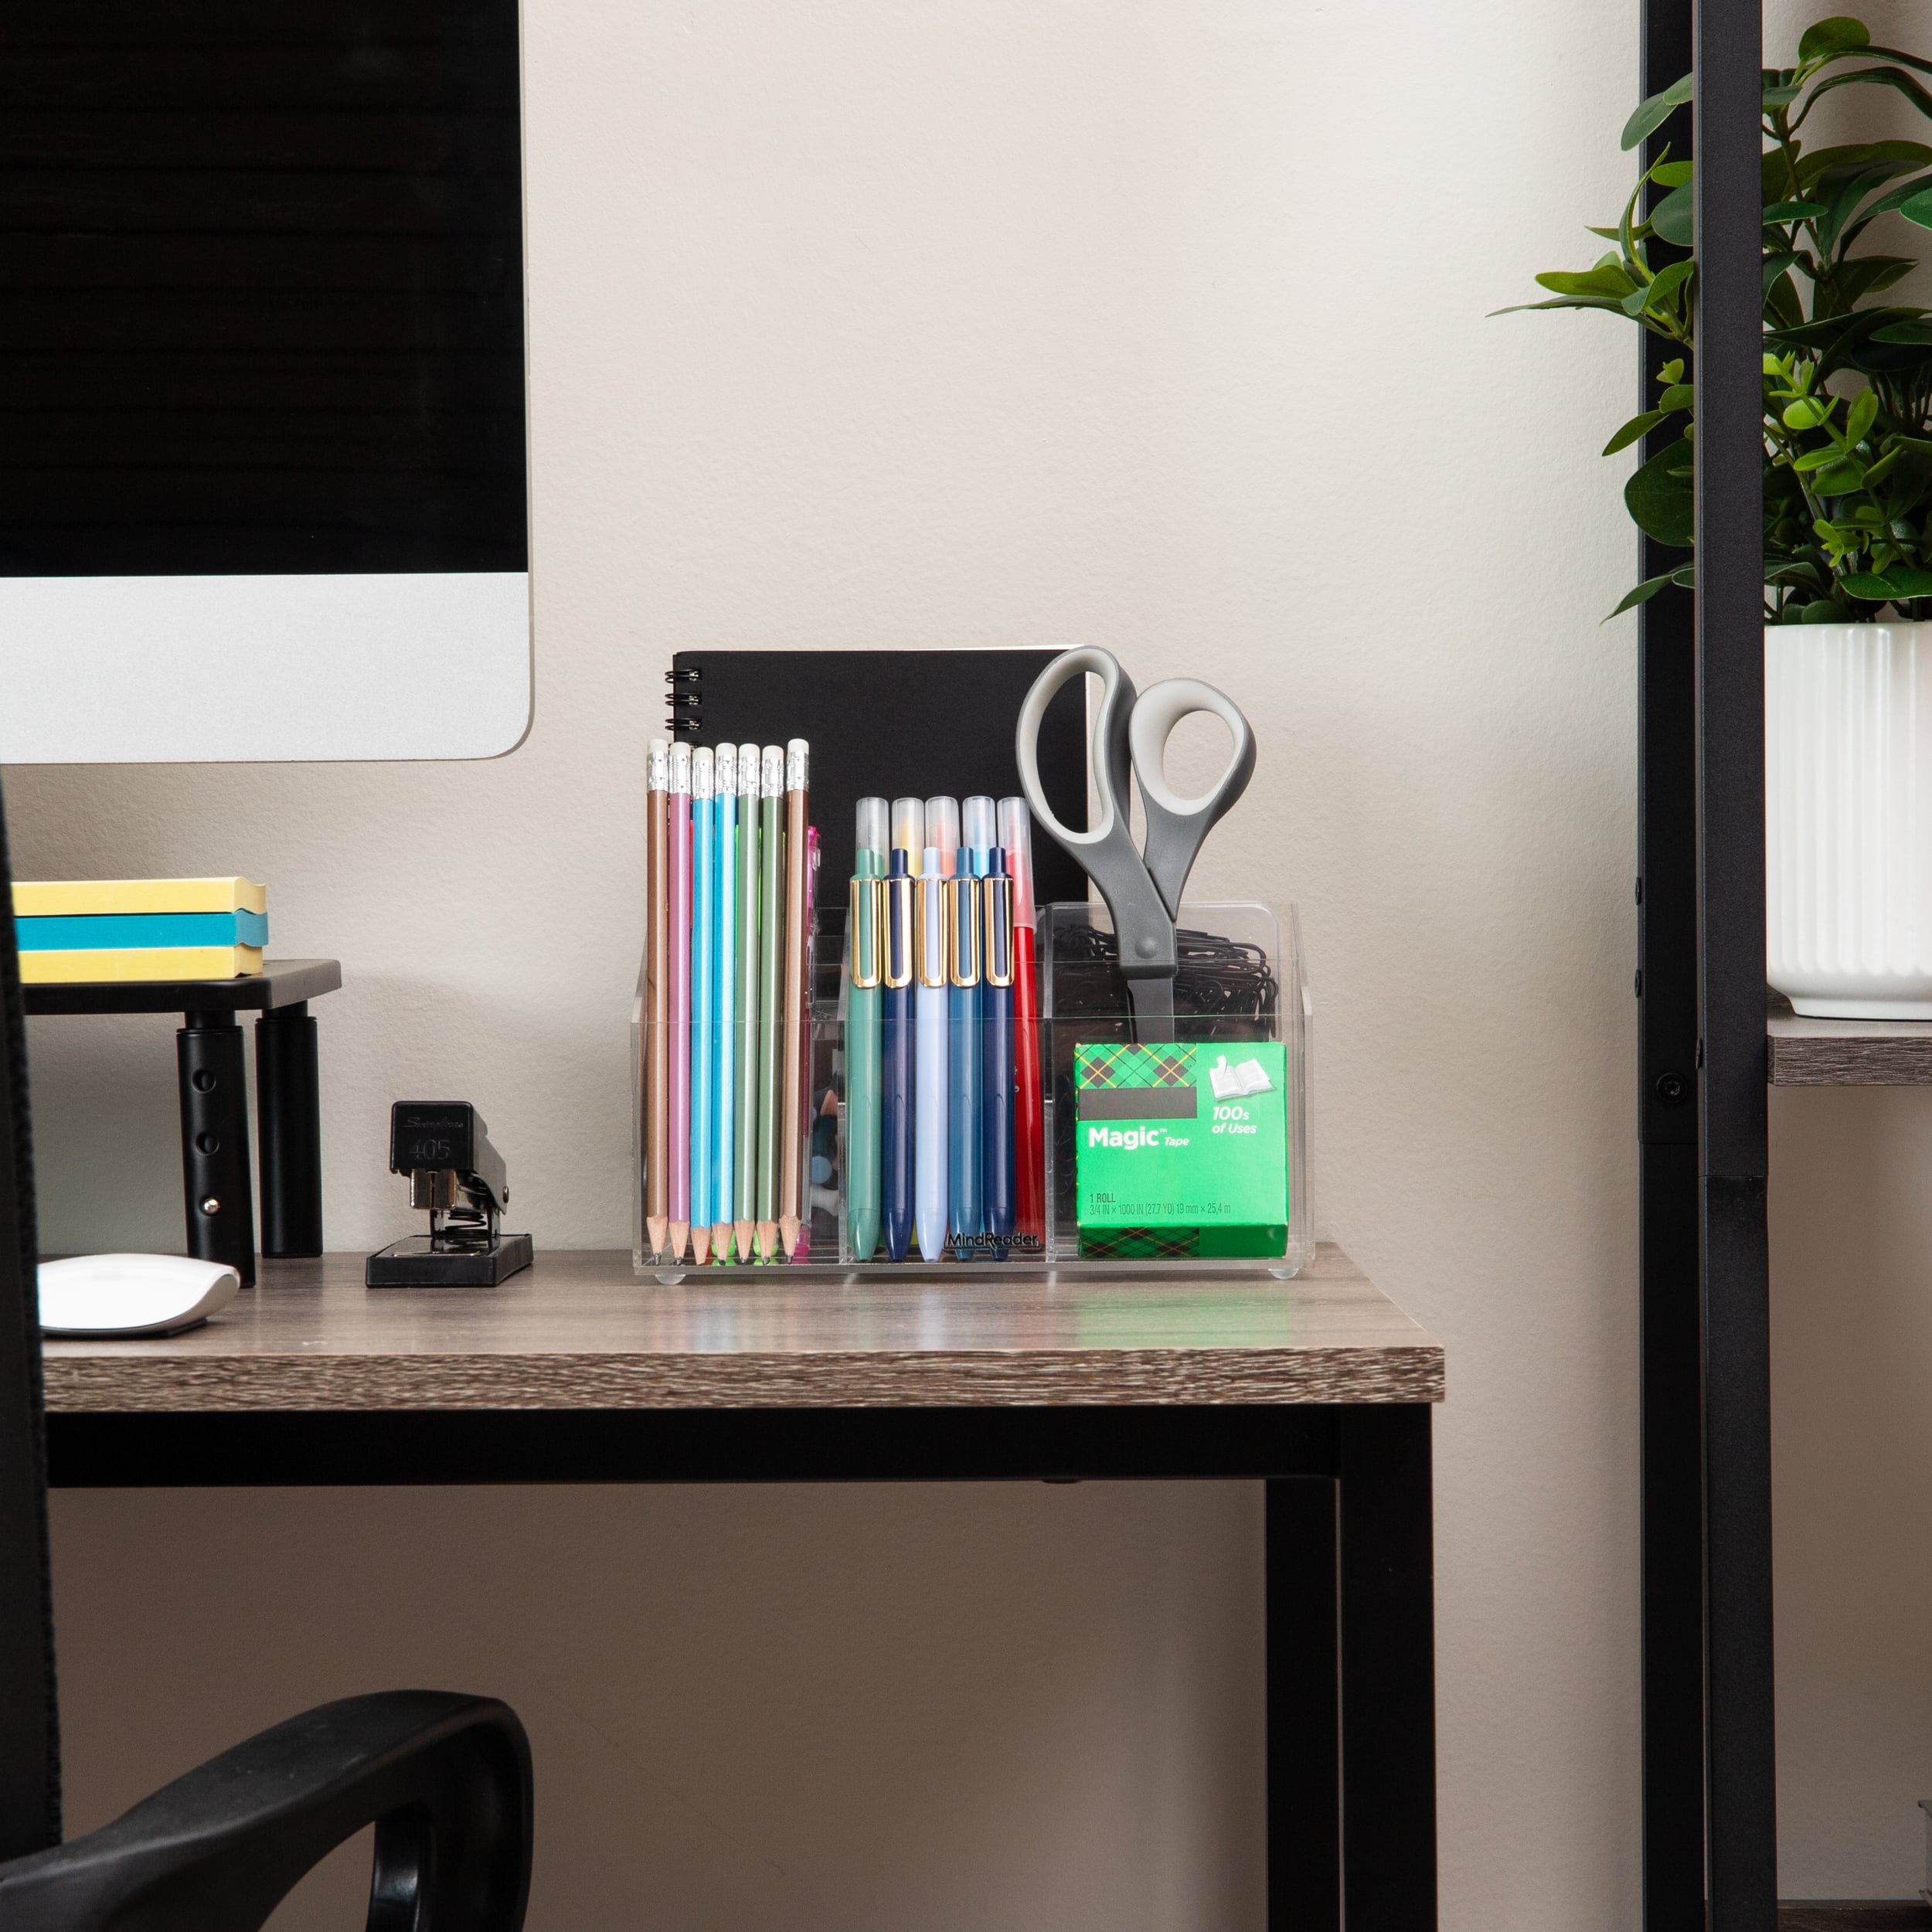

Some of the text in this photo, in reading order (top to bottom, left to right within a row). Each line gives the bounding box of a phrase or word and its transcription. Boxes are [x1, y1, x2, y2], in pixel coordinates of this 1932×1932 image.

[1213, 1106, 1250, 1121] 100s
[1212, 1123, 1257, 1134] of Uses
[408, 1138, 451, 1160] 405
[1164, 1137, 1190, 1147] Tape
[1090, 1192, 1117, 1203] 1 ROLL
[1090, 1204, 1100, 1216] 3/4
[1102, 1204, 1110, 1216] IN
[1118, 1203, 1135, 1216] 1000
[1136, 1203, 1144, 1215] IN
[1145, 1202, 1162, 1216] (27.7
[1162, 1202, 1175, 1216] YD)
[1176, 1202, 1184, 1214] 19
[1185, 1205, 1199, 1214] mm
[1207, 1202, 1223, 1216] 25,4
[1224, 1204, 1231, 1213] m
[947, 1232, 1038, 1248] MindReader
